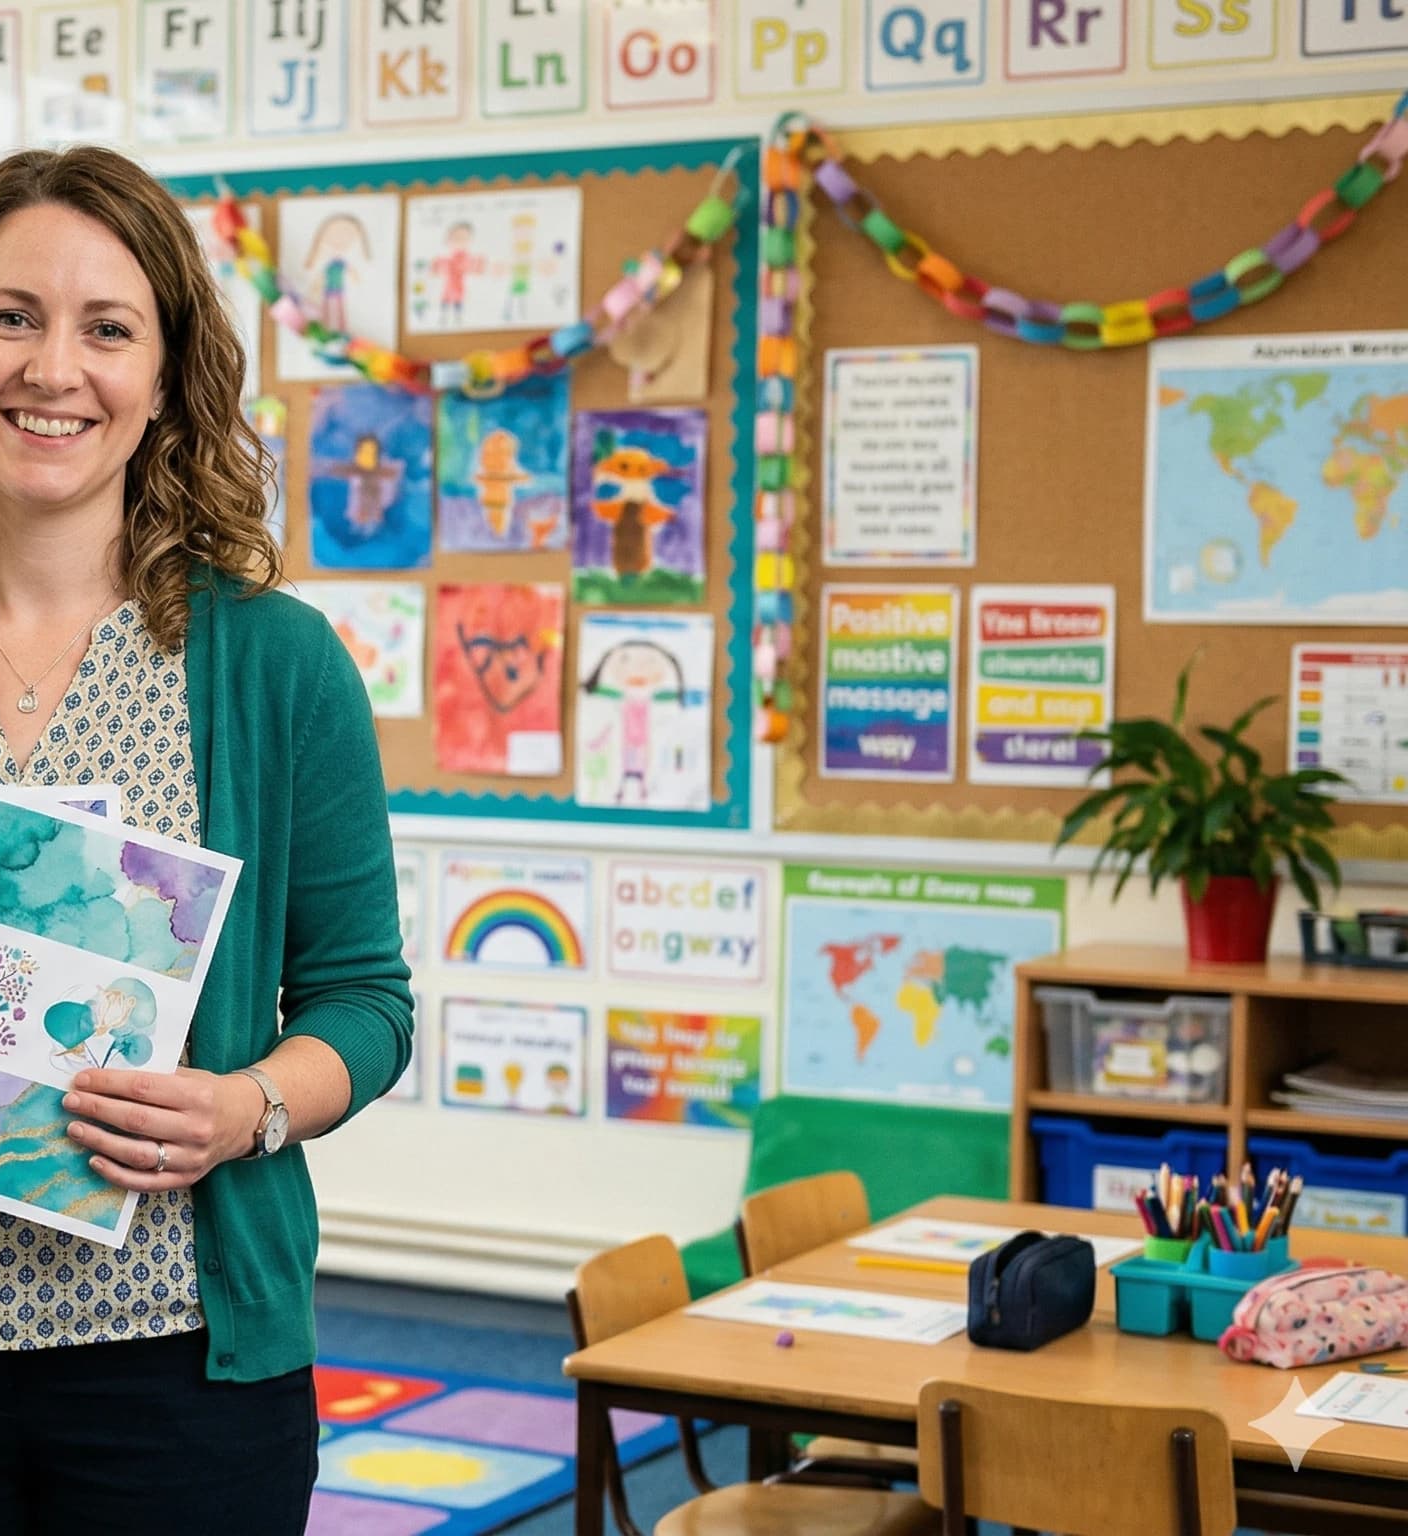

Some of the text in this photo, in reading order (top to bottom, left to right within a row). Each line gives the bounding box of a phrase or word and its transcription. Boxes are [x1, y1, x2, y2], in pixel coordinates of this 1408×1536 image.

[54, 18, 105, 58] Ee
[162, 9, 210, 49] Fr
[880, 7, 971, 73] Qq
[1029, 0, 1102, 48] Rr
[1173, 0, 1251, 37] Ss
[377, 46, 448, 97] Kk
[750, 17, 829, 85] Pp
[270, 59, 319, 122] Jj
